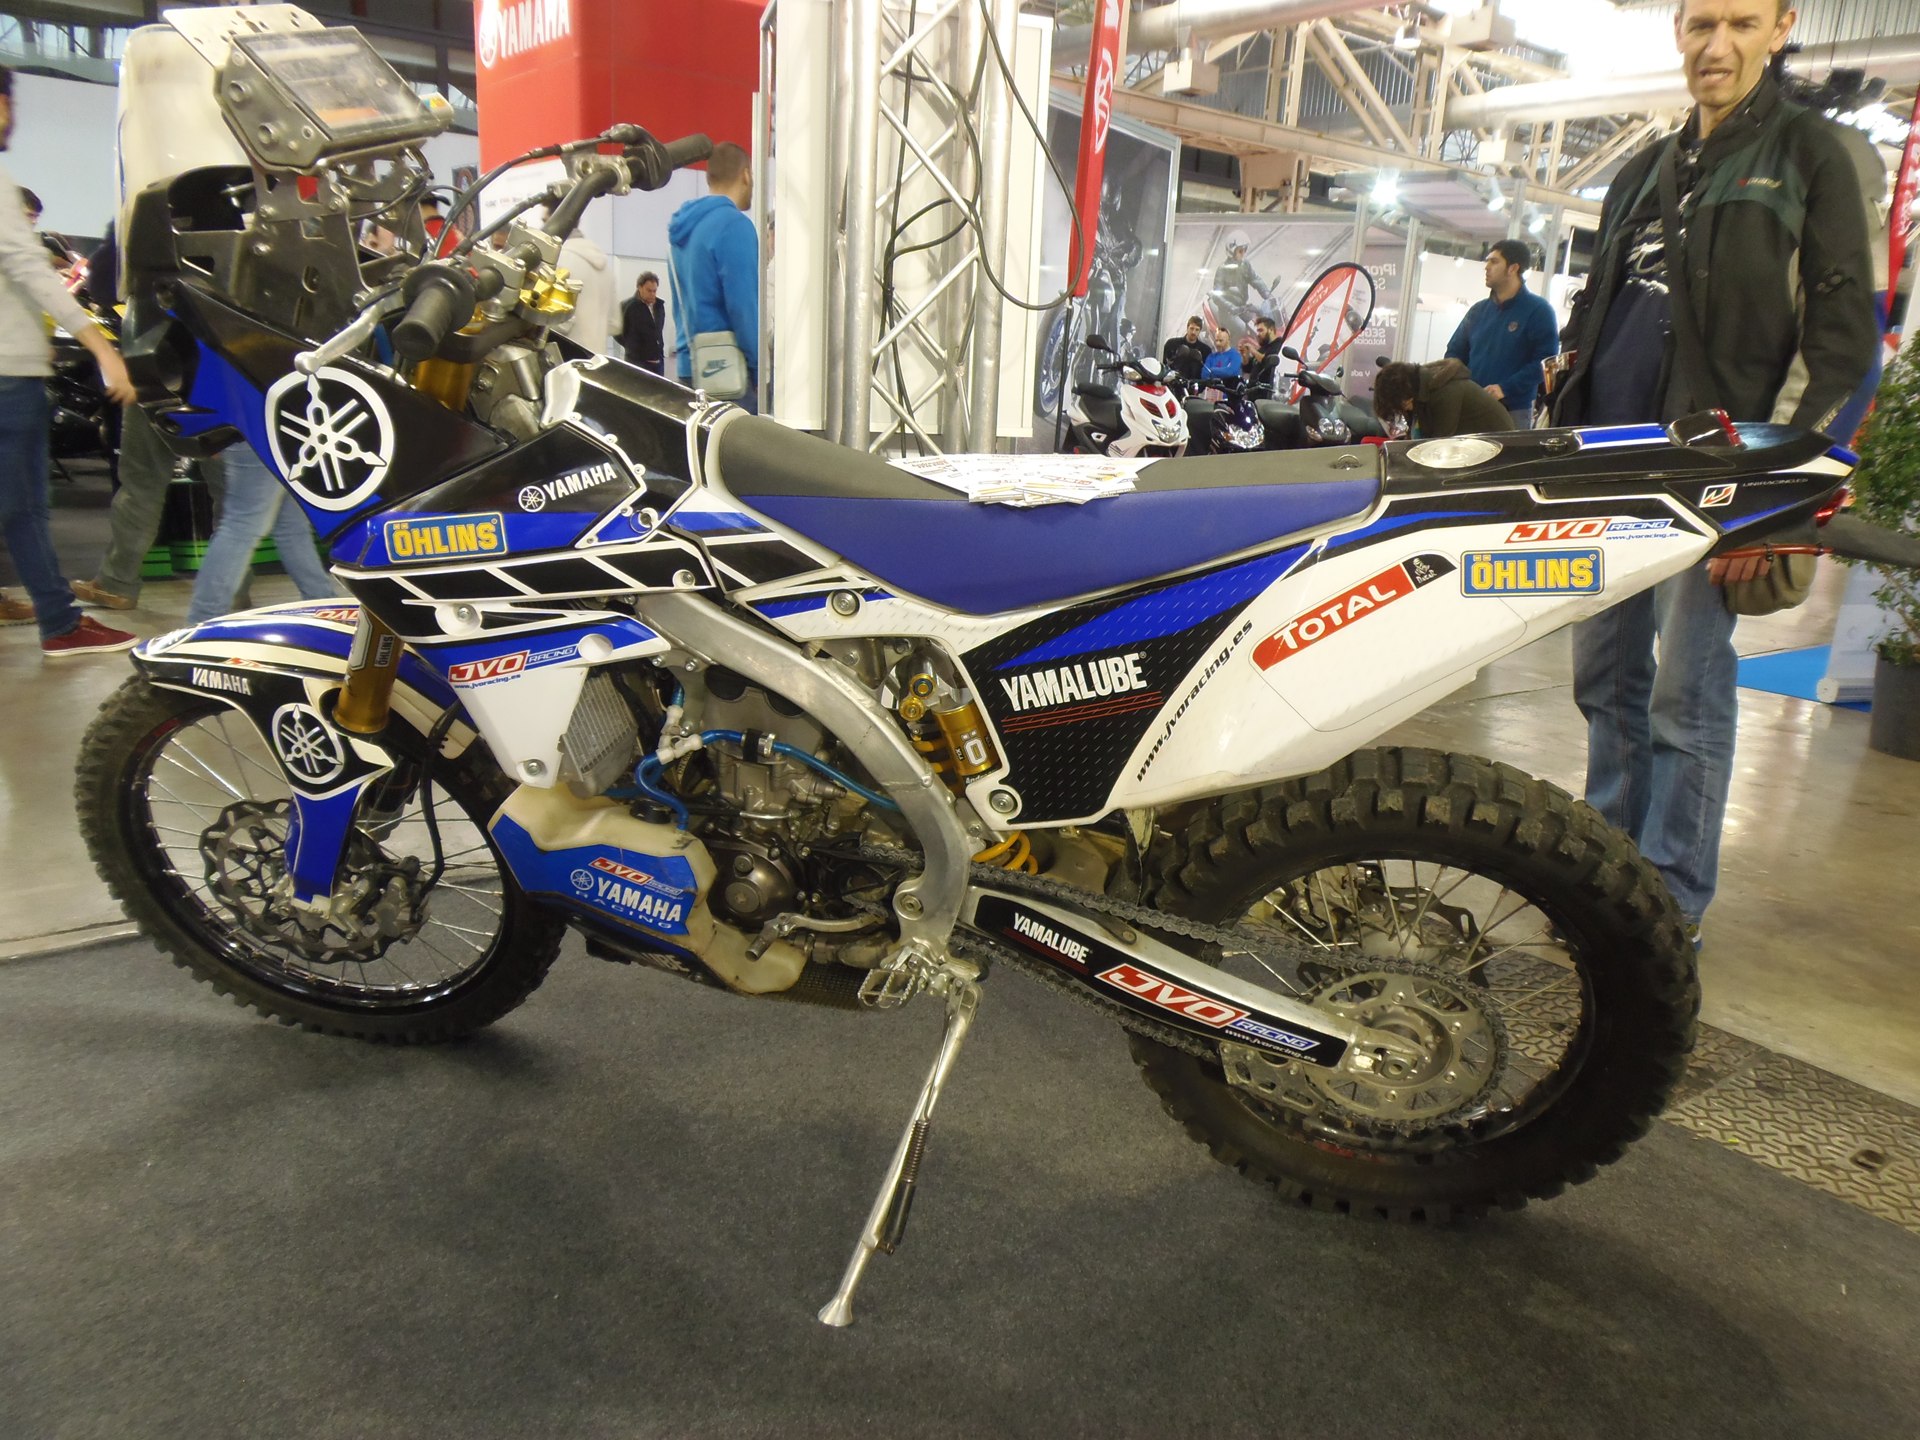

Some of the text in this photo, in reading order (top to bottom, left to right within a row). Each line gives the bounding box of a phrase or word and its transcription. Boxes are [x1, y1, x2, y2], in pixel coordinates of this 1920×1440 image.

[497, 0, 570, 58] YAMAHA
[543, 461, 618, 501] YAMAHA
[392, 522, 499, 557] ÖHLINS
[1510, 519, 1667, 542] JVO RACING
[1606, 532, 1679, 541] www.jvoracing.es
[1471, 554, 1595, 590] ÖHLINS
[1272, 584, 1397, 650] TOTAL
[192, 667, 252, 696] YAMAHA
[451, 647, 573, 681] JVO RACING
[454, 674, 521, 689] www.jvoracing.es
[999, 652, 1147, 712] YAMALUBE
[1136, 619, 1253, 782] www.jvoracing.es
[593, 861, 649, 883] JVO
[575, 890, 672, 929] RACING
[597, 877, 682, 922] YAMAHA
[1013, 912, 1090, 964] YAMALUBE
[1108, 972, 1311, 1048] JVO RACING
[1225, 1029, 1318, 1063] www.jvoracing.es
